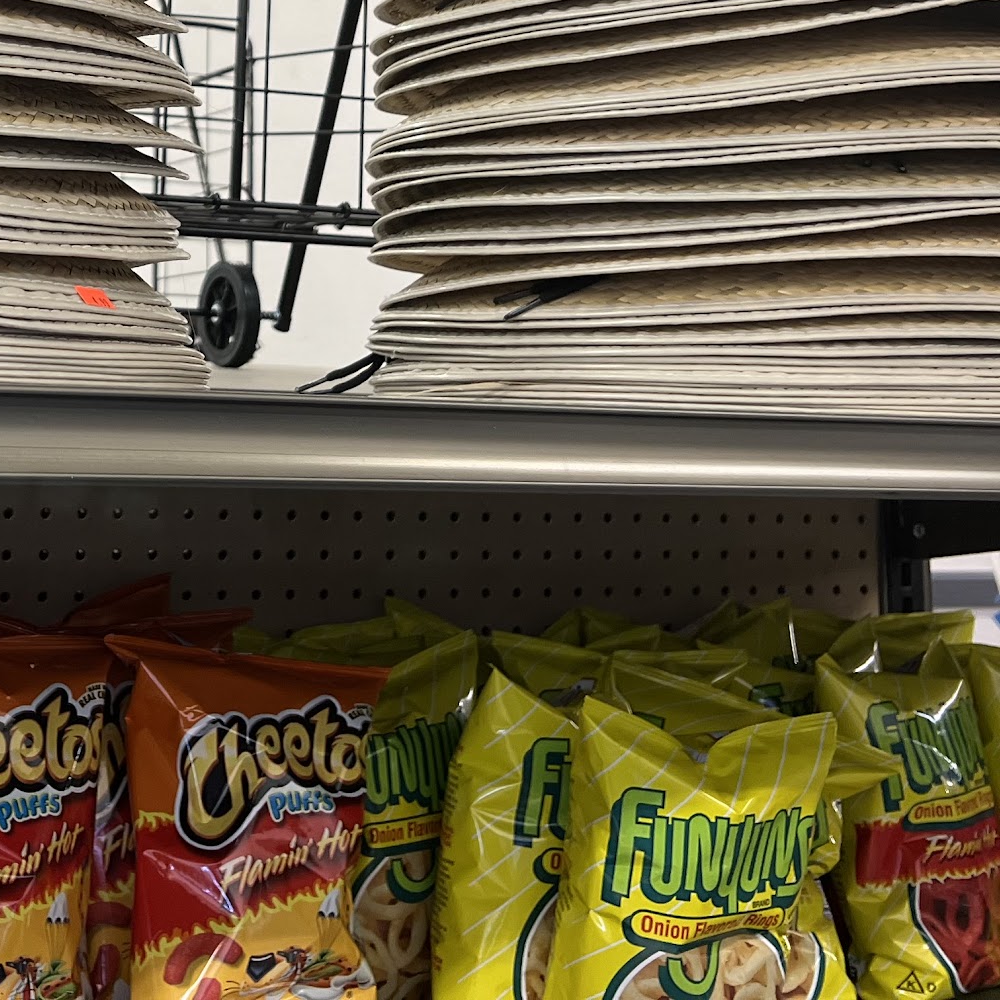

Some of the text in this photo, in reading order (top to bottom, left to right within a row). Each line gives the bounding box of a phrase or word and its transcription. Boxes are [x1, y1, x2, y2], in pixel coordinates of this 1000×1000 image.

[47, 821, 84, 863] Hot
[316, 819, 363, 860] Hot
[641, 914, 690, 940] Onion
[743, 913, 780, 928] Rings
